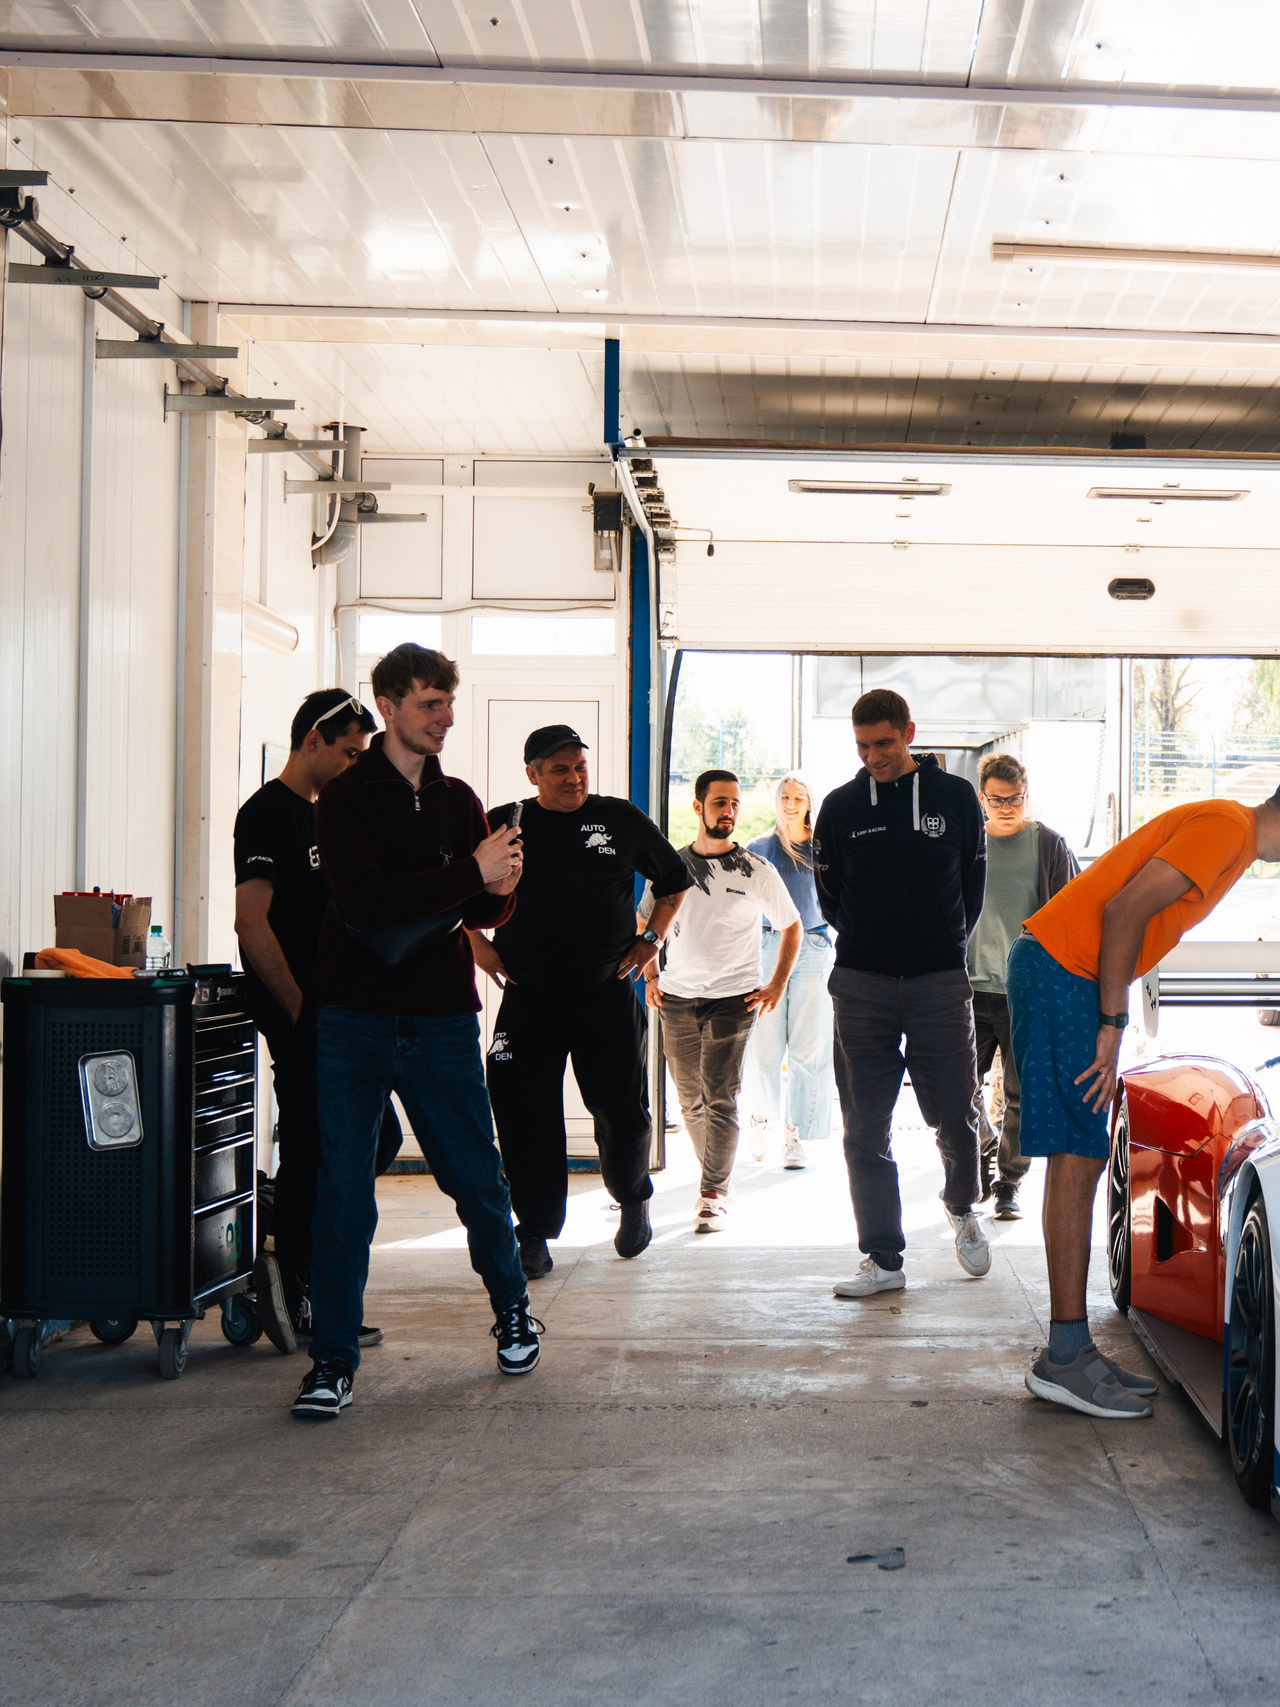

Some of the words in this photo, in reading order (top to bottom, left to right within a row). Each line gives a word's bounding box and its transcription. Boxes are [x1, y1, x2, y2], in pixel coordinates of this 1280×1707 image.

[580, 824, 606, 832] AUTO
[598, 846, 616, 856] DEN
[495, 1052, 513, 1061] DEN
